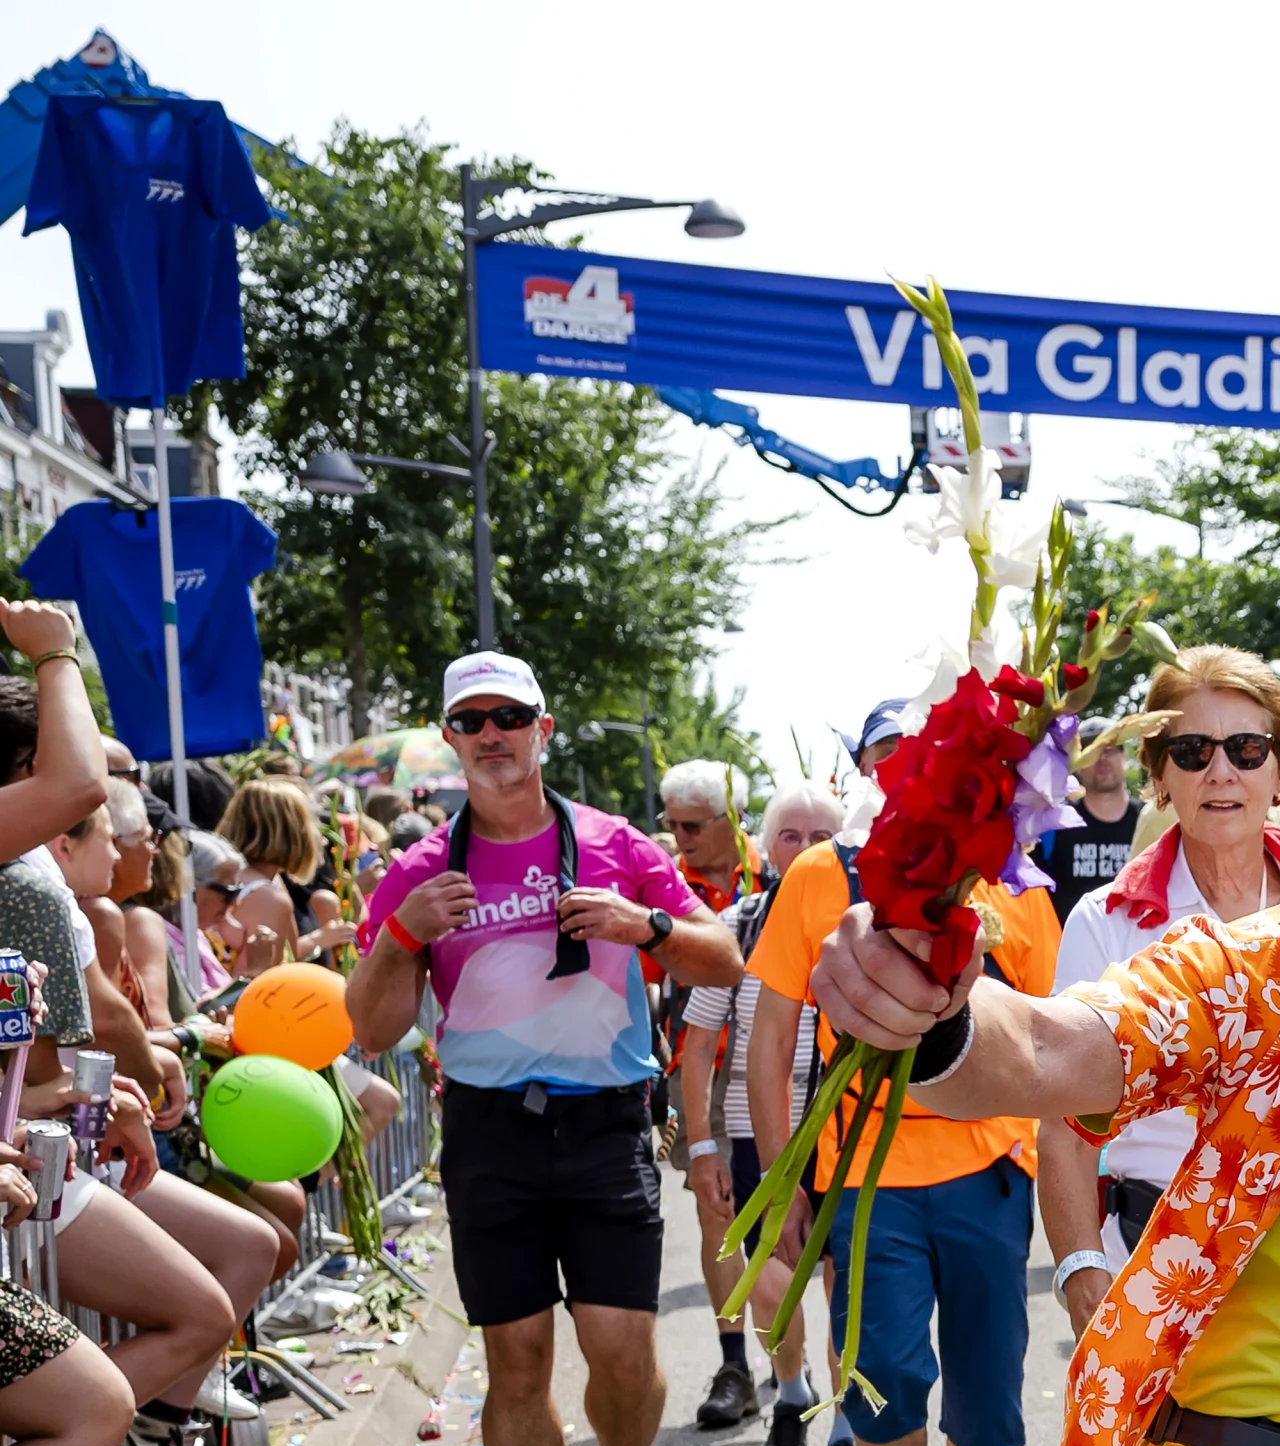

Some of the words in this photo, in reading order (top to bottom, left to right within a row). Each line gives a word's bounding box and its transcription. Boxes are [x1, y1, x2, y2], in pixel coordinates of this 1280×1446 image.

[568, 265, 627, 323] 4
[532, 319, 629, 345] DAAGSE
[845, 305, 1009, 396] Via
[1073, 843, 1097, 860] NO
[1072, 860, 1096, 877] NO
